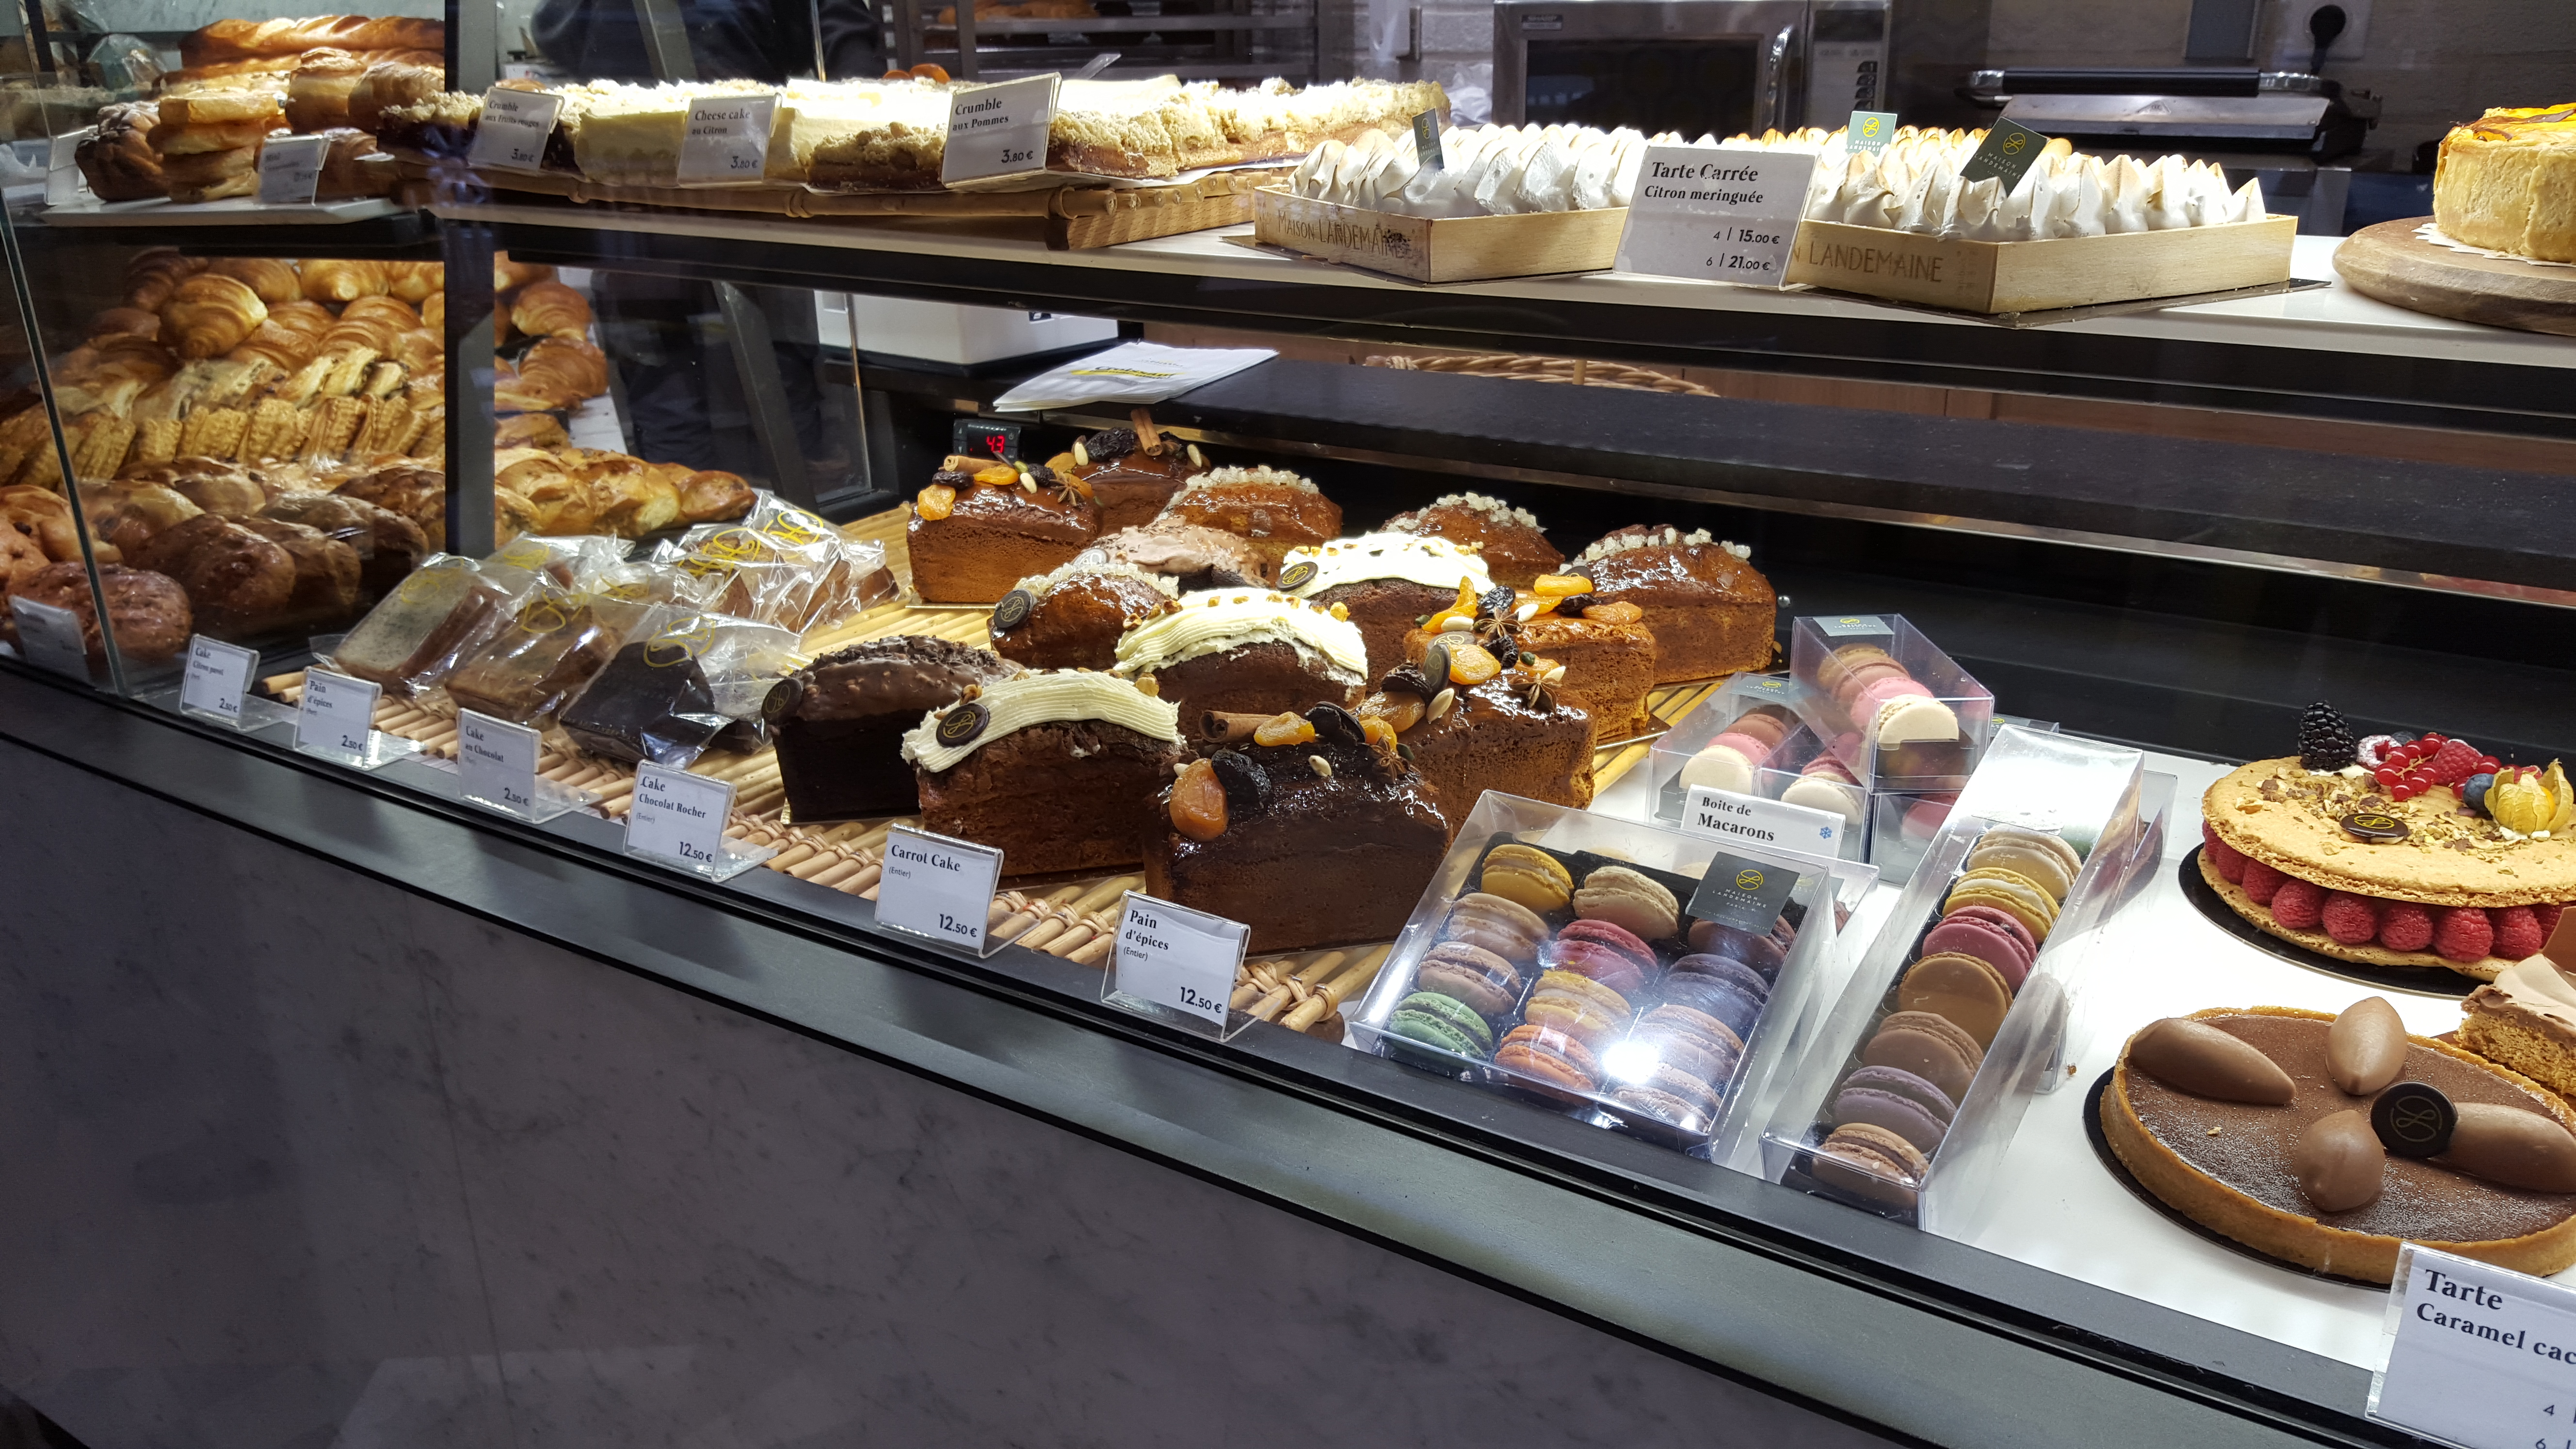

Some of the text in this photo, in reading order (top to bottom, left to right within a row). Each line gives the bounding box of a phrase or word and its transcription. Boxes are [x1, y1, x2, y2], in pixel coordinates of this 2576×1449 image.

[489, 100, 519, 112] Crumble
[695, 108, 751, 121] Cheese cake
[955, 97, 1002, 115] Crumble
[498, 115, 516, 124] Fruits
[518, 119, 539, 128] rouges
[703, 126, 727, 135] Citron
[952, 115, 1009, 131] aux Pommes
[730, 156, 750, 169] 3.80
[1001, 149, 1033, 163] 3.80 €
[1987, 152, 2017, 169] MAISON
[1651, 161, 1760, 181] Tarte Carrée
[1974, 153, 2022, 179] LANDEMAINE
[1644, 185, 1764, 206] Citron meringuée
[1278, 209, 1315, 241] MAISON
[1713, 231, 1721, 241] 4
[1739, 229, 1770, 243] 15.00
[1771, 235, 1780, 244] €
[1706, 257, 1713, 266] 6
[1728, 255, 1760, 270] 21.00
[1762, 262, 1771, 270] €
[1808, 241, 1944, 282] LANDEMAINE
[986, 435, 1005, 453] 43
[195, 647, 211, 659] Cake
[309, 680, 326, 693] Pain
[466, 725, 484, 741] Cake
[465, 743, 473, 752] au
[474, 744, 504, 763] Chocolat
[641, 776, 666, 791] Cake
[639, 793, 707, 819] Chocolat Rocher
[1701, 796, 1752, 816] Boite de
[1697, 813, 1775, 841] Macarons
[679, 841, 712, 863] 12.50 €
[891, 844, 961, 871] Carrot Cake
[888, 866, 911, 879] (Entier)
[1712, 890, 1768, 909] LANDEMAINE
[1725, 888, 1758, 901] MAISON
[939, 914, 977, 937] 12.50 €
[1129, 909, 1157, 929] Pain
[1126, 929, 1169, 950] d'épices
[1123, 946, 1148, 962] (Entier)
[1180, 986, 1223, 1014] 12.50 €
[2425, 1269, 2503, 1310] Tarte
[2416, 1303, 2576, 1365] Caramel cac
[2543, 1404, 2555, 1417] 4
[2535, 1438, 2546, 1449] 6
